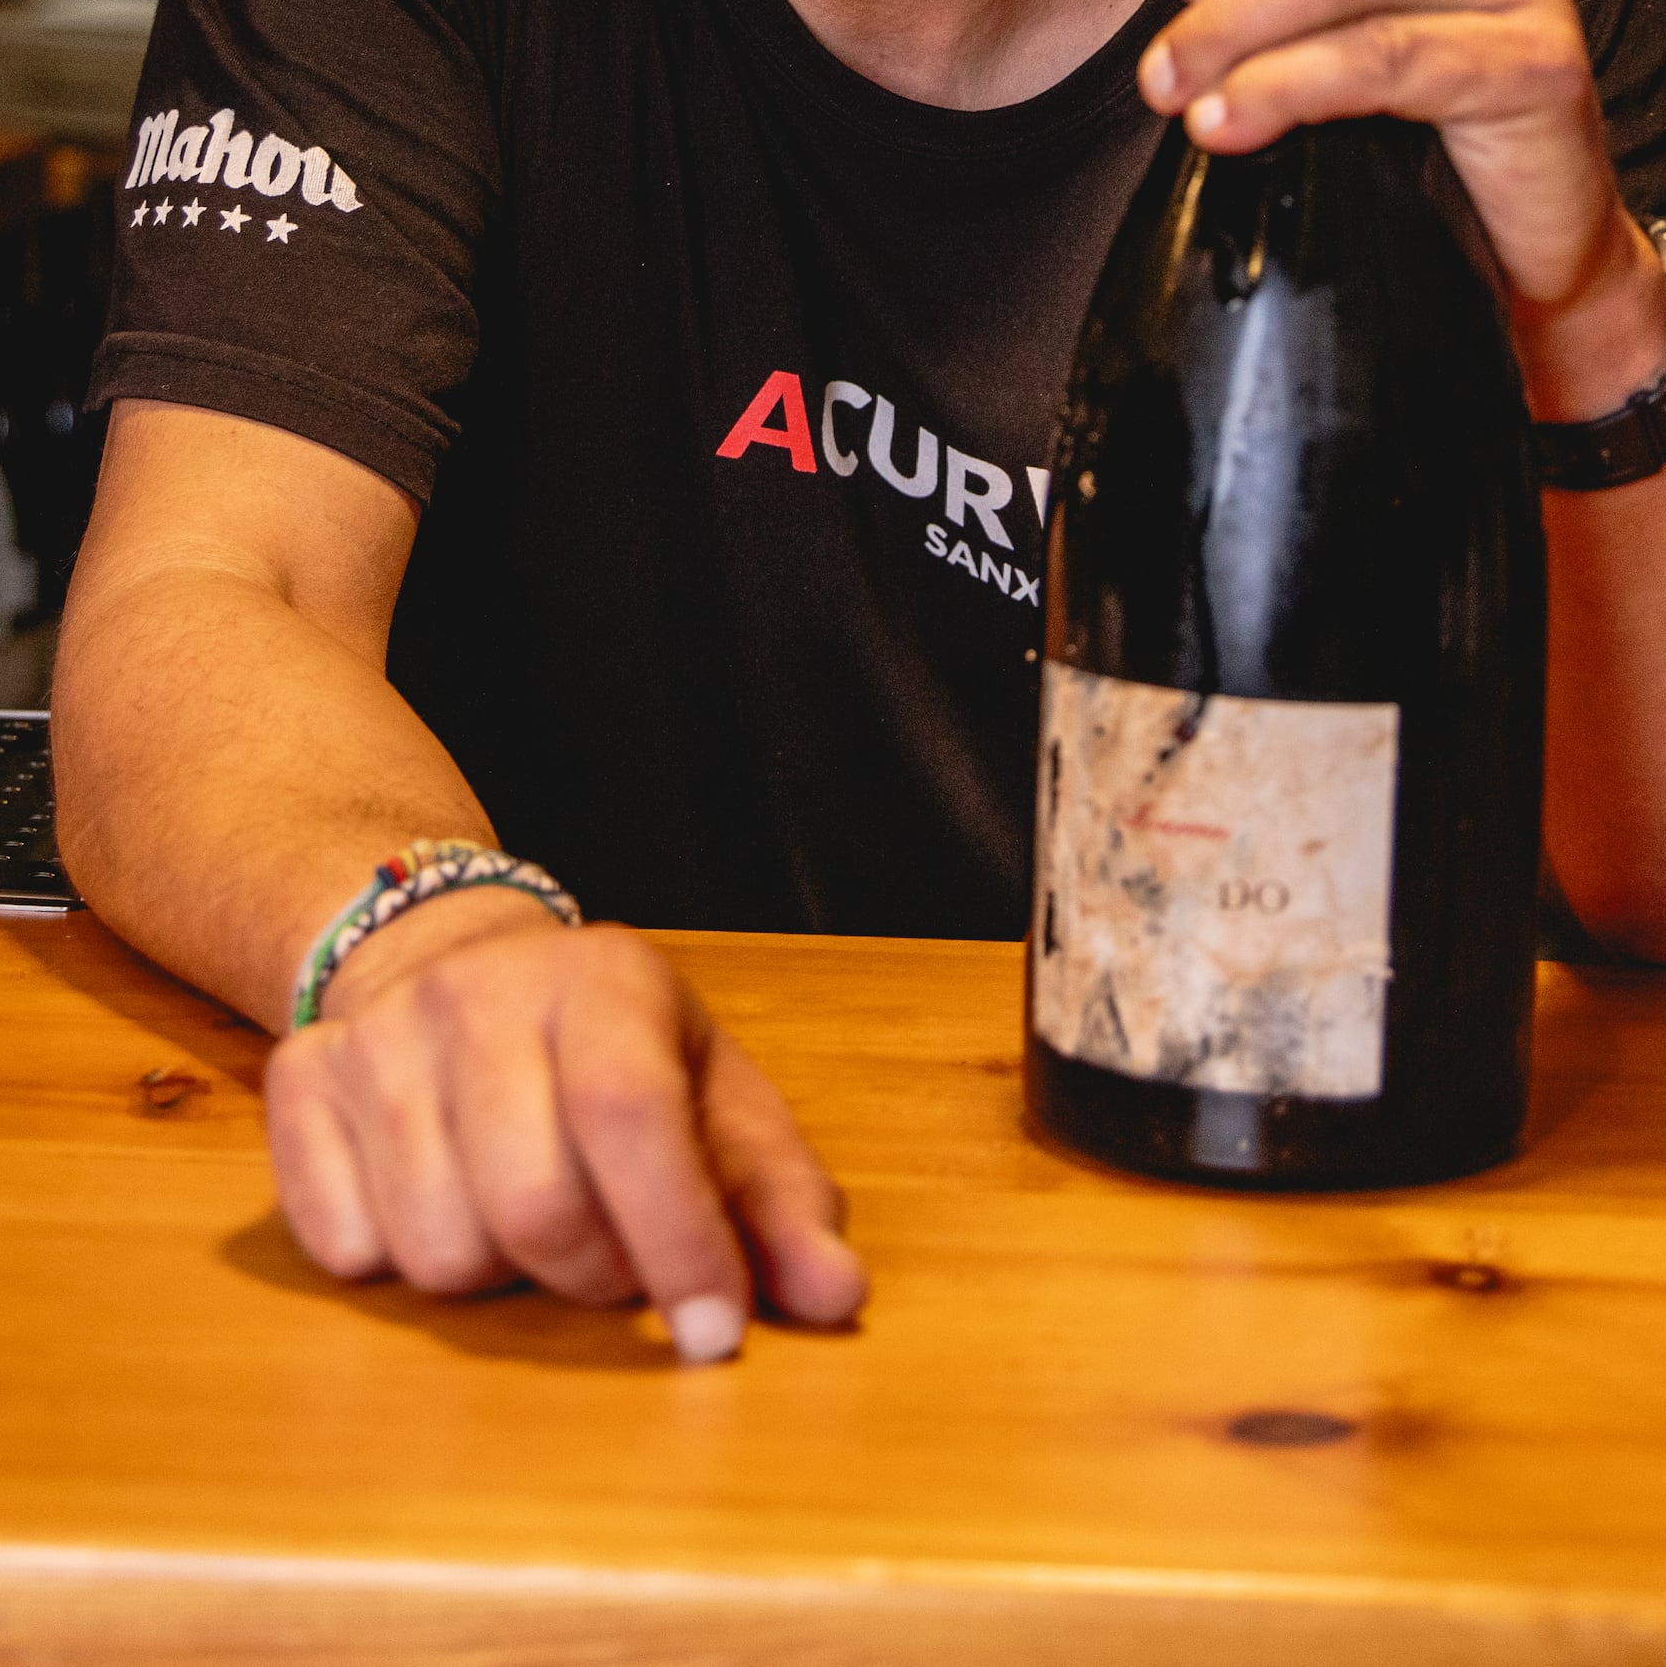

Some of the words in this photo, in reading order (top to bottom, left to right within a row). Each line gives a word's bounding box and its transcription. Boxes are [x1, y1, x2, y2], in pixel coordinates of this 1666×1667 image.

[125, 108, 364, 213] Mahou
[923, 523, 1041, 608] SANX
[1218, 878, 1290, 915] DO
